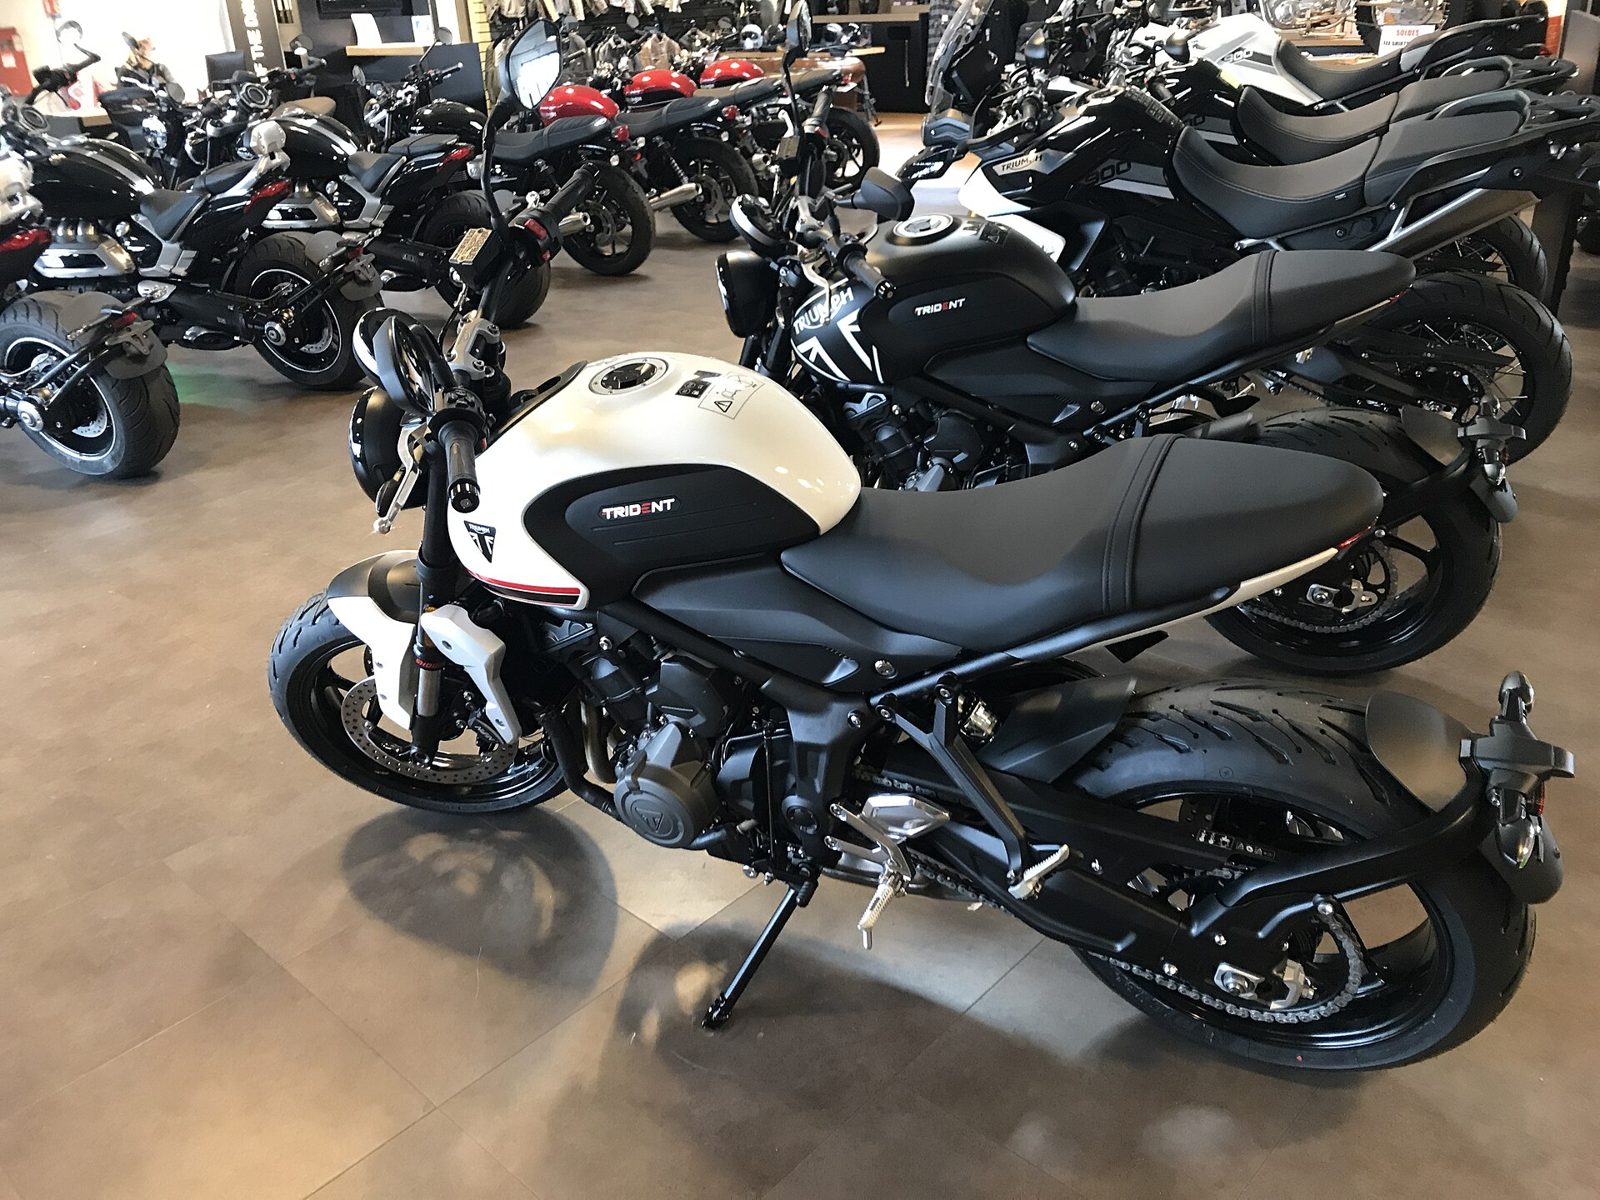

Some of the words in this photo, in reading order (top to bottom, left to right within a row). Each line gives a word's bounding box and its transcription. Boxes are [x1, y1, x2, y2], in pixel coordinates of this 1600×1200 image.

[247, 29, 265, 61] THE
[1223, 46, 1254, 63] 900
[1085, 160, 1131, 184] 900
[914, 297, 966, 317] TRIDENT
[601, 498, 676, 520] TRIDENT
